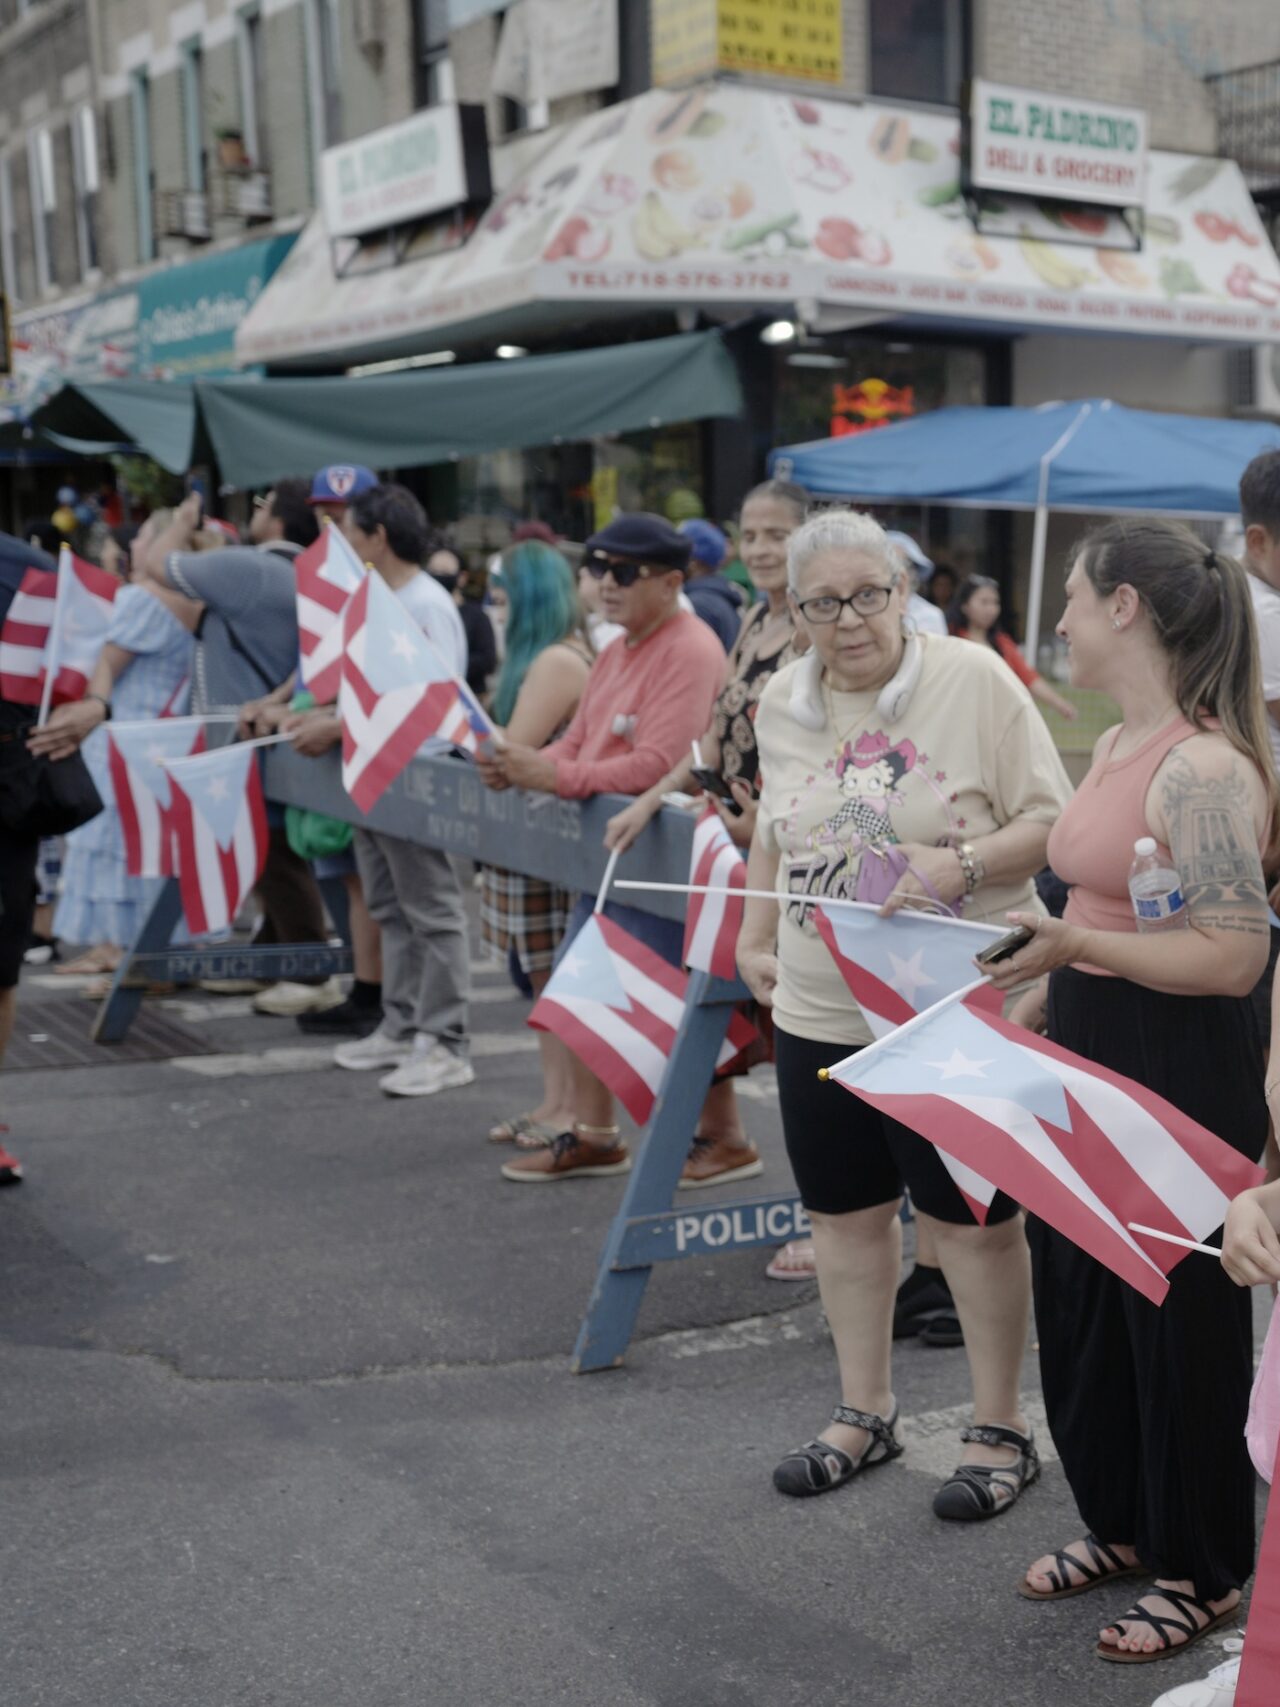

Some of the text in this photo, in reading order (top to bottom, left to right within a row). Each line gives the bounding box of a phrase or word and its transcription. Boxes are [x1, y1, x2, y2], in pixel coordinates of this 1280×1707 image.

[988, 98, 1138, 152] EL PADRINO
[986, 147, 1136, 187] DELI & GROCERY
[167, 954, 264, 979] POLICE
[676, 1203, 813, 1251] POLICE
